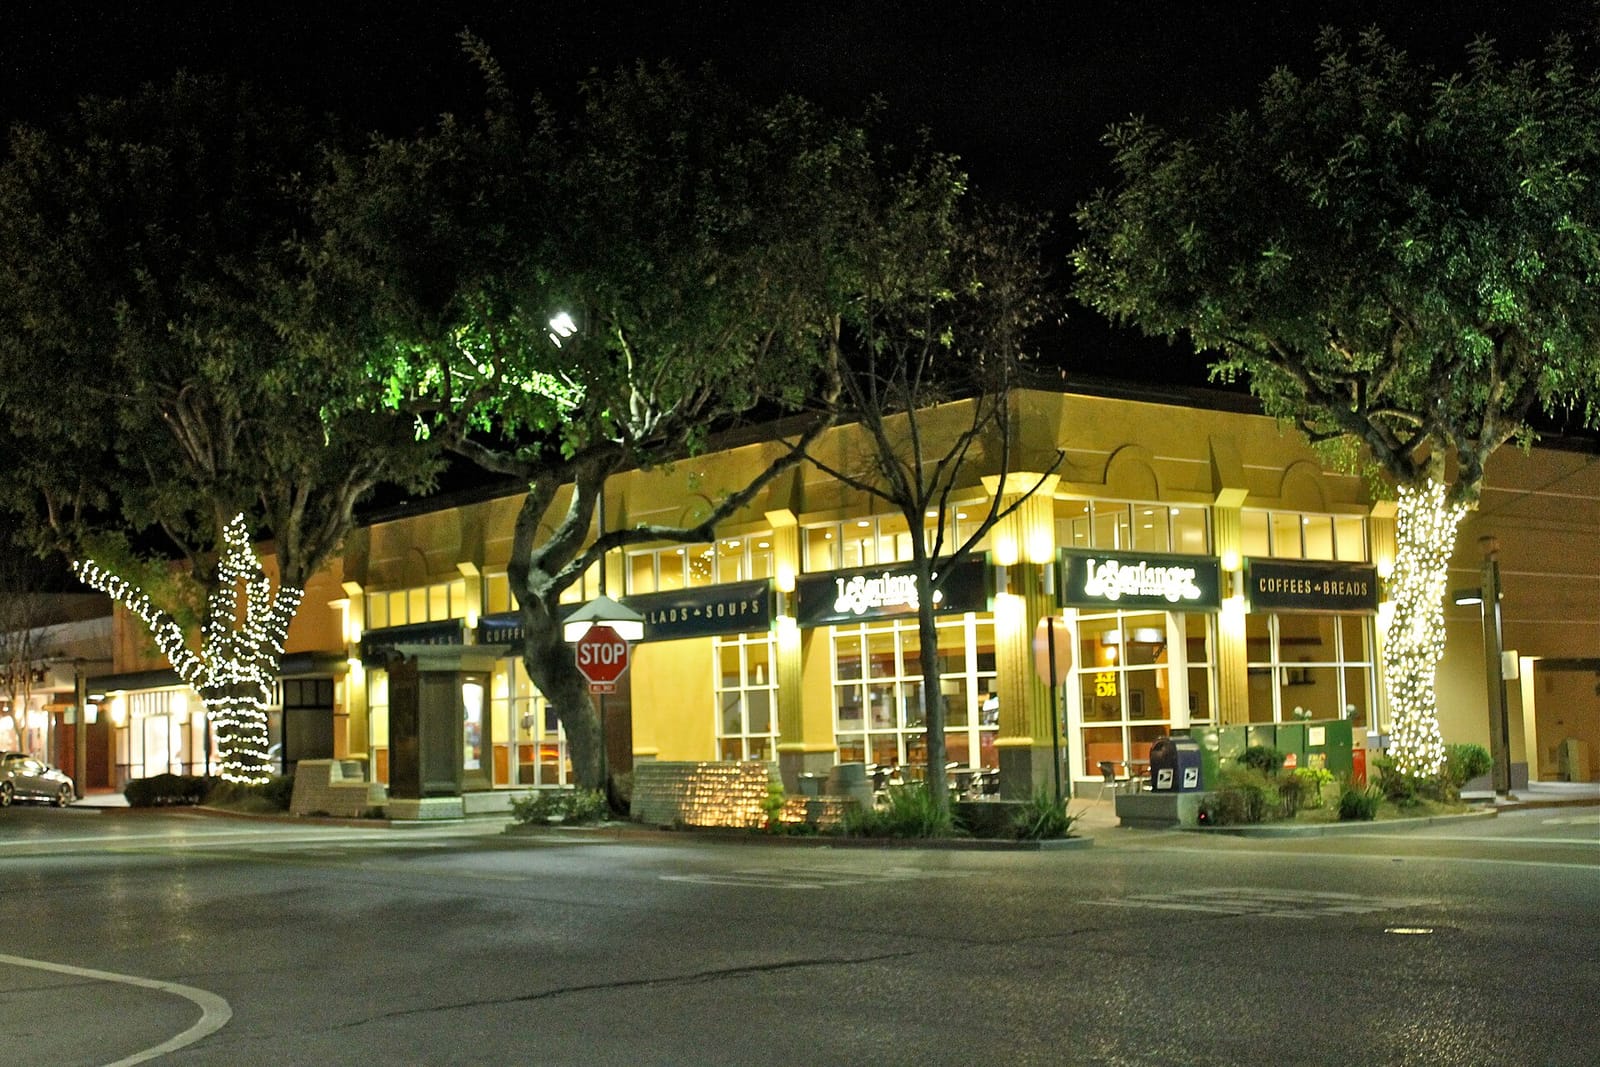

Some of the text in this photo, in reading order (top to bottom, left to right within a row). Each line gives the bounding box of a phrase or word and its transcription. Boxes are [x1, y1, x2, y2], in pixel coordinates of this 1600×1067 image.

[1259, 578, 1311, 594] COFFEES
[1323, 580, 1368, 596] BREADS
[706, 600, 759, 618] SOUPS
[580, 643, 625, 665] STOP
